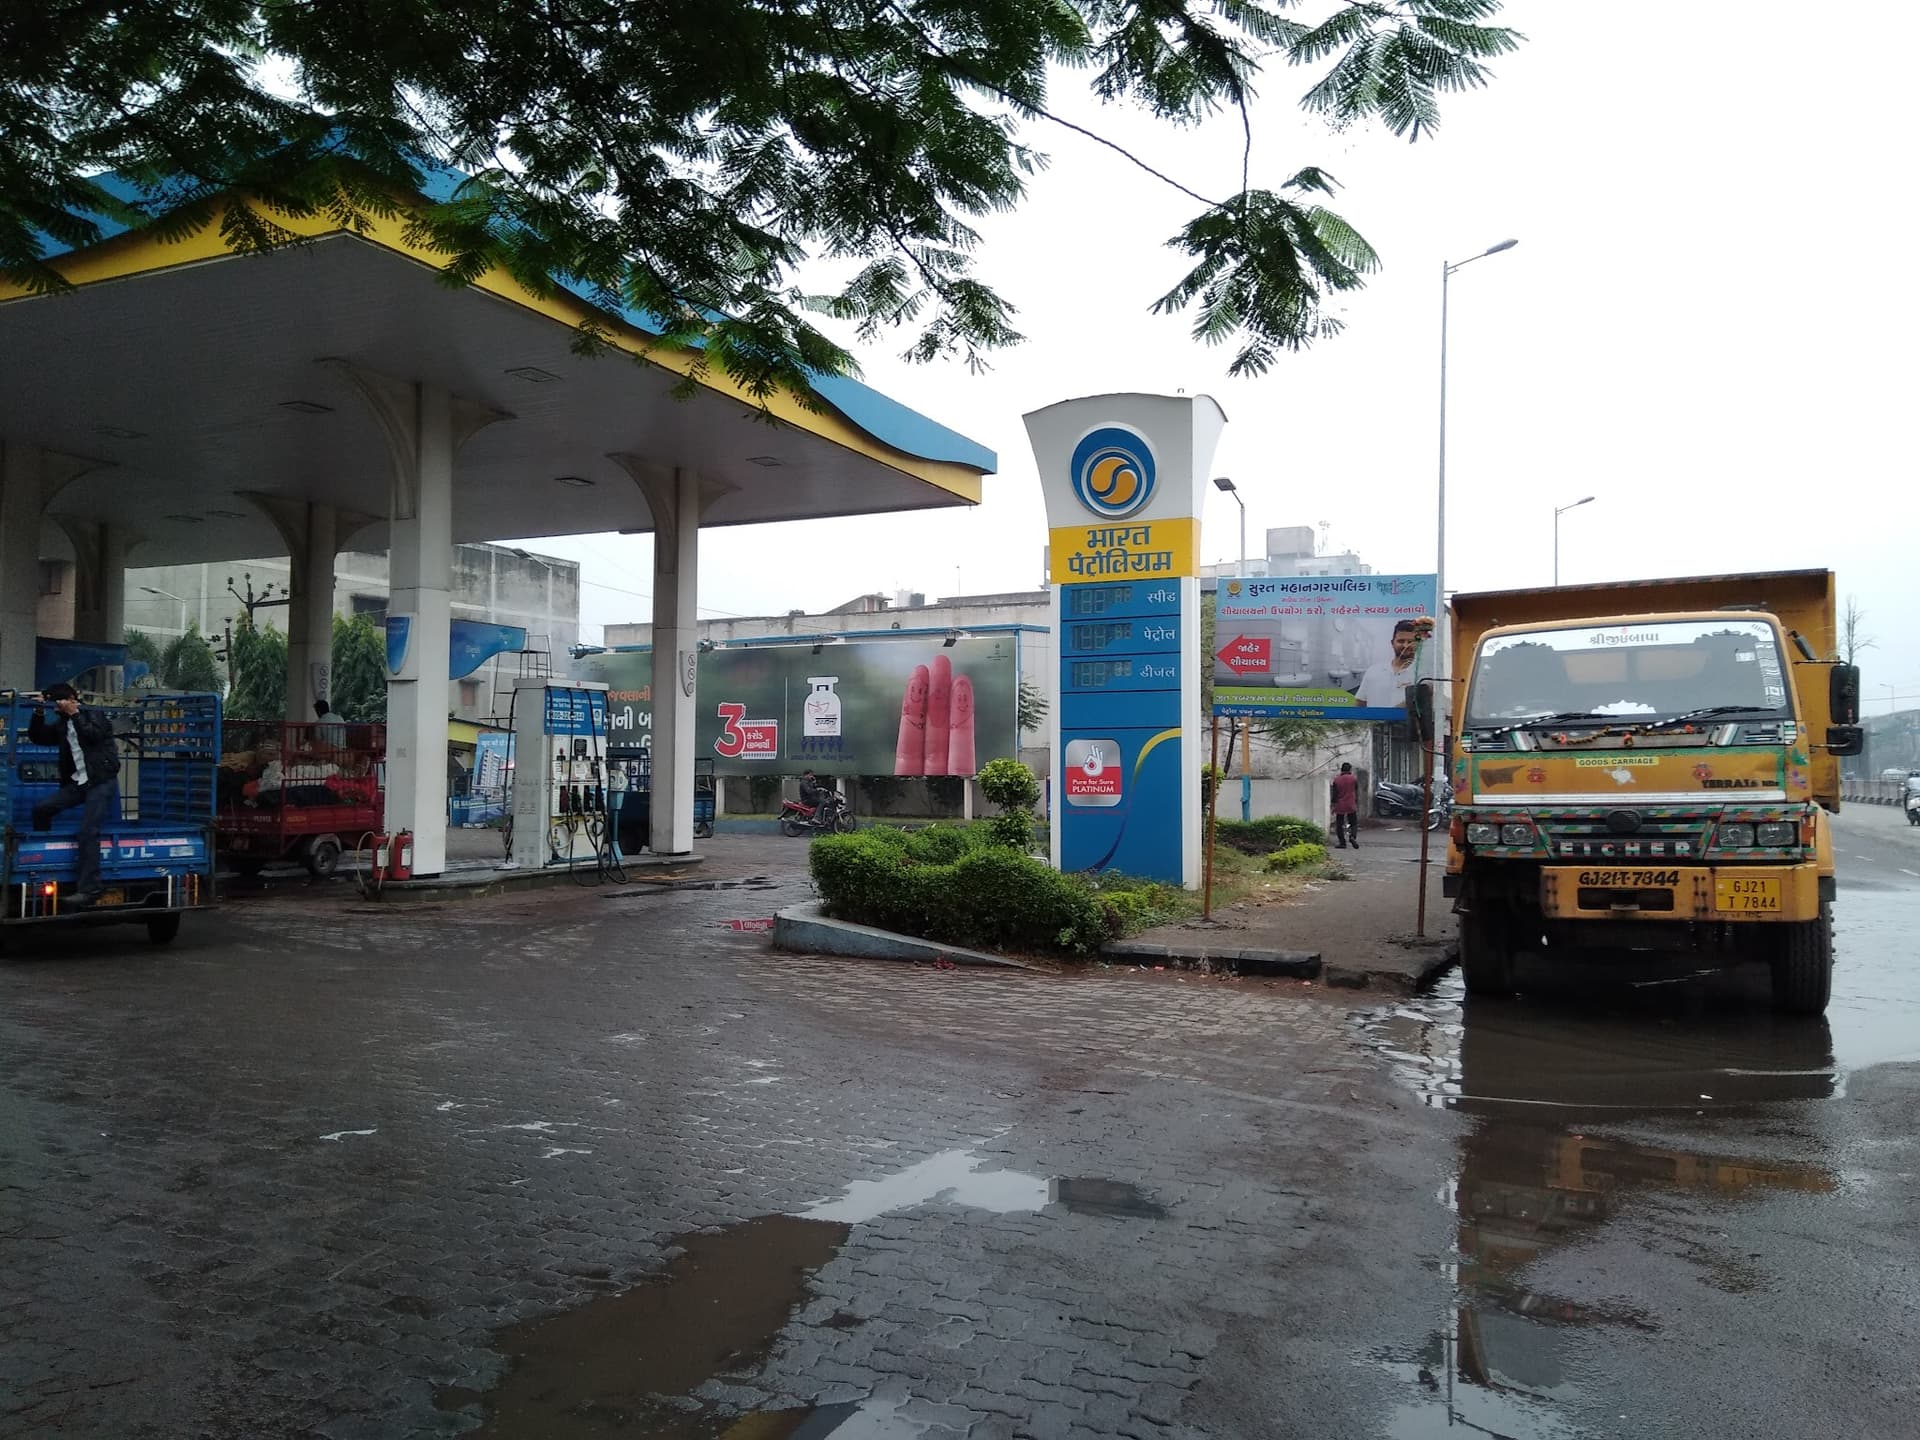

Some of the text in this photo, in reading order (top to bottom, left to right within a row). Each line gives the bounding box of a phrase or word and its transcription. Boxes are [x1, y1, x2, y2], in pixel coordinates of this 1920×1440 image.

[1087, 526, 1151, 548] भारत
[1249, 583, 1275, 597] સુરત
[1280, 578, 1371, 593] મહાનગરપાલિકા
[1147, 589, 1176, 603] स्पीड
[1143, 626, 1176, 642] पेट्रोल
[1237, 643, 1260, 652] જાહેર
[1139, 664, 1176, 678] डीजल
[714, 702, 746, 757] 3
[1579, 757, 1654, 766] GOODS CARRIAGE
[1560, 841, 1692, 857] EICHER
[1733, 881, 1767, 894] GJ21
[1728, 896, 1777, 908] T 7844
